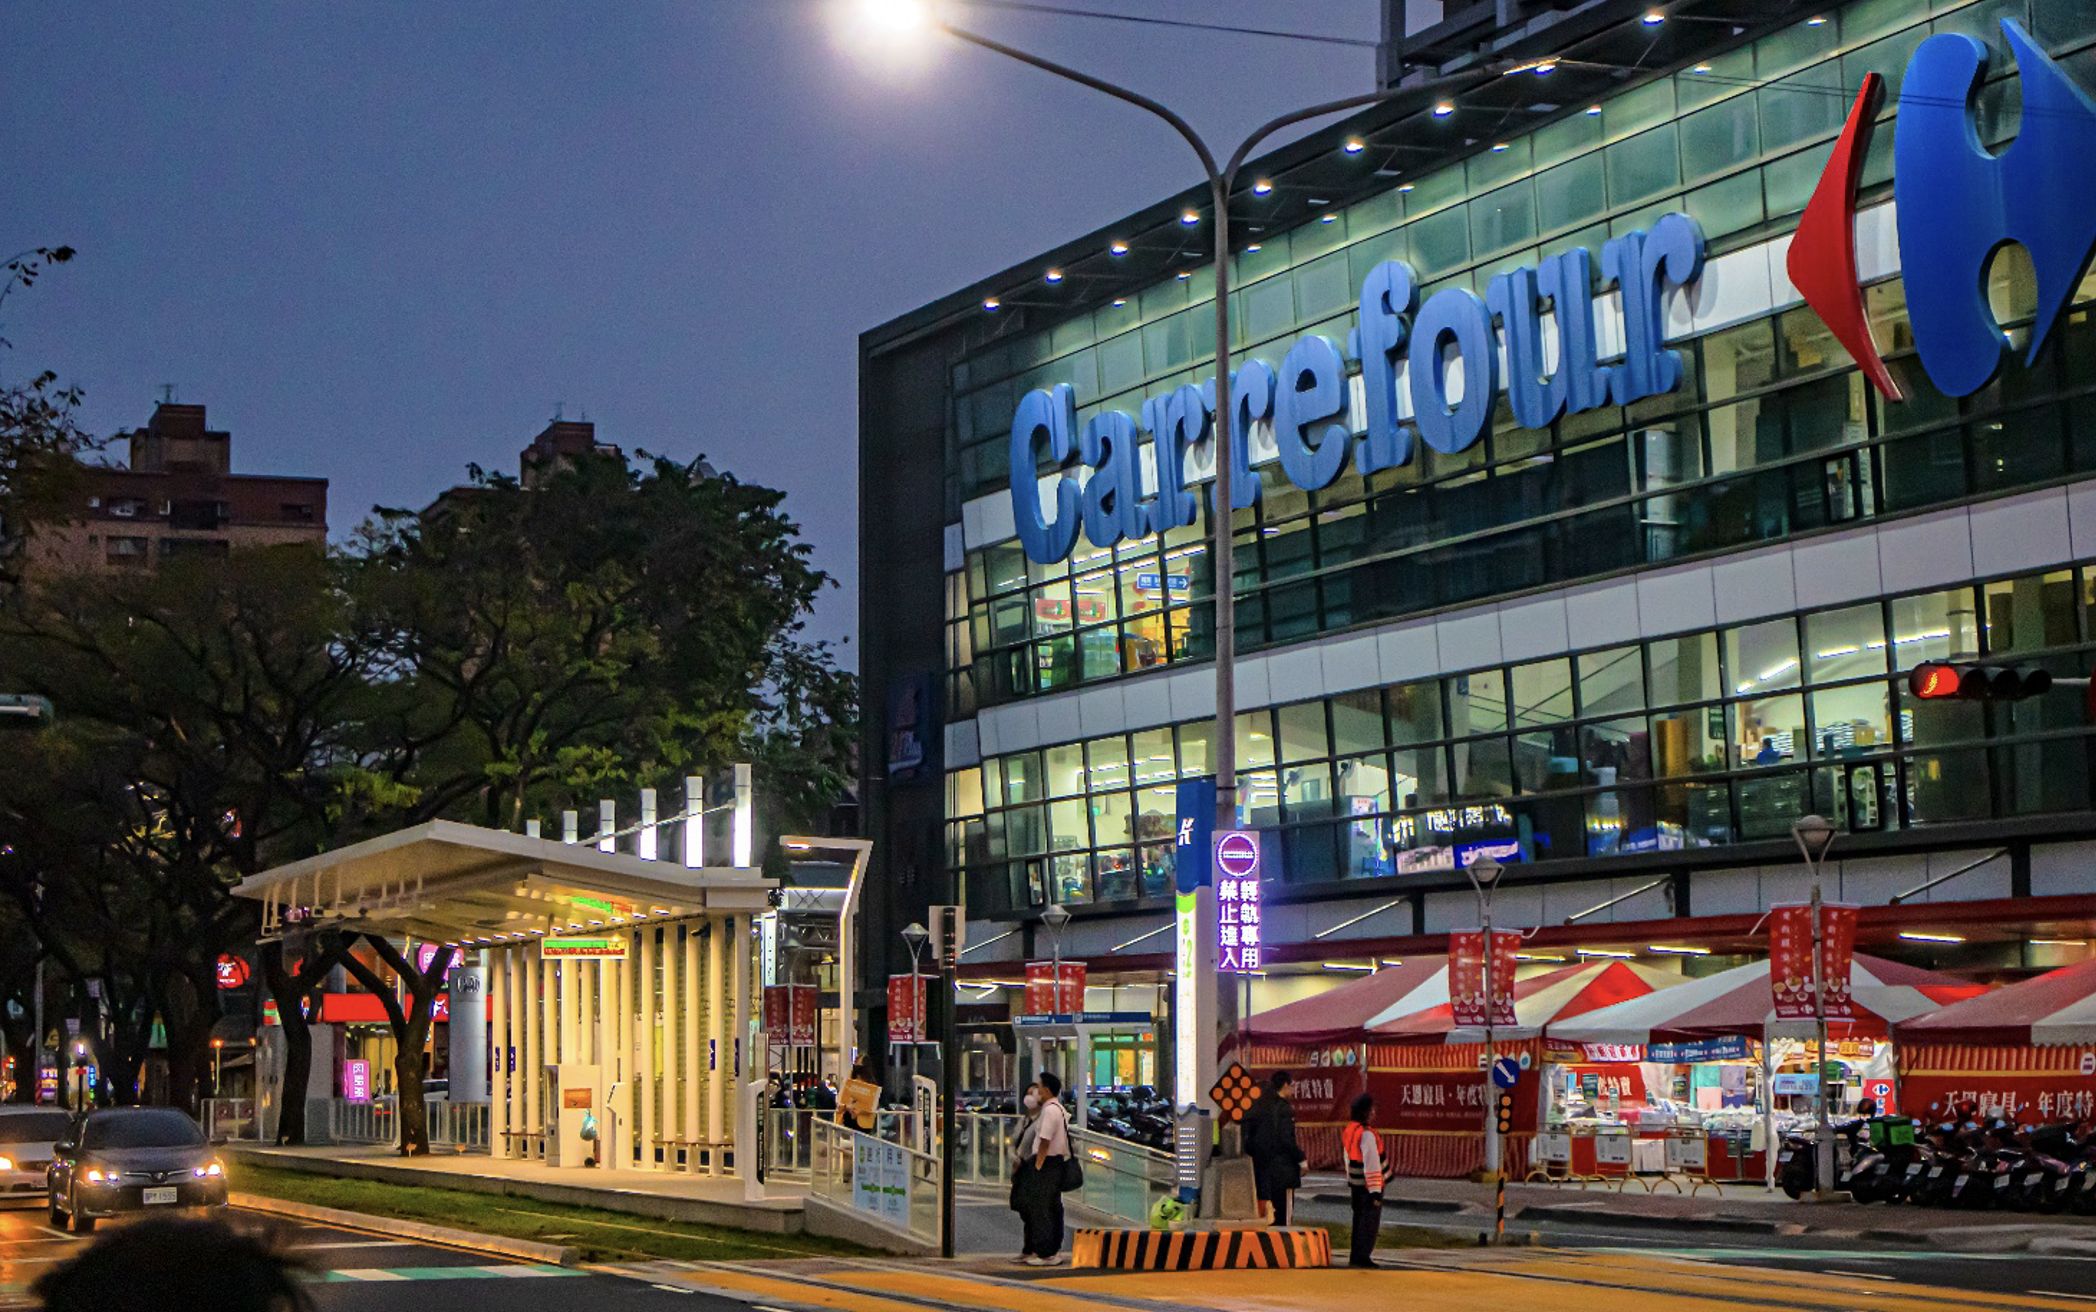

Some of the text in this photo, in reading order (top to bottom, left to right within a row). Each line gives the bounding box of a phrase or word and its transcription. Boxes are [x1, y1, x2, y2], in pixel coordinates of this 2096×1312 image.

[1010, 212, 1705, 565] Carrefour
[1219, 880, 1239, 968] 禁止進入
[1240, 880, 1260, 968] 輕軌專用
